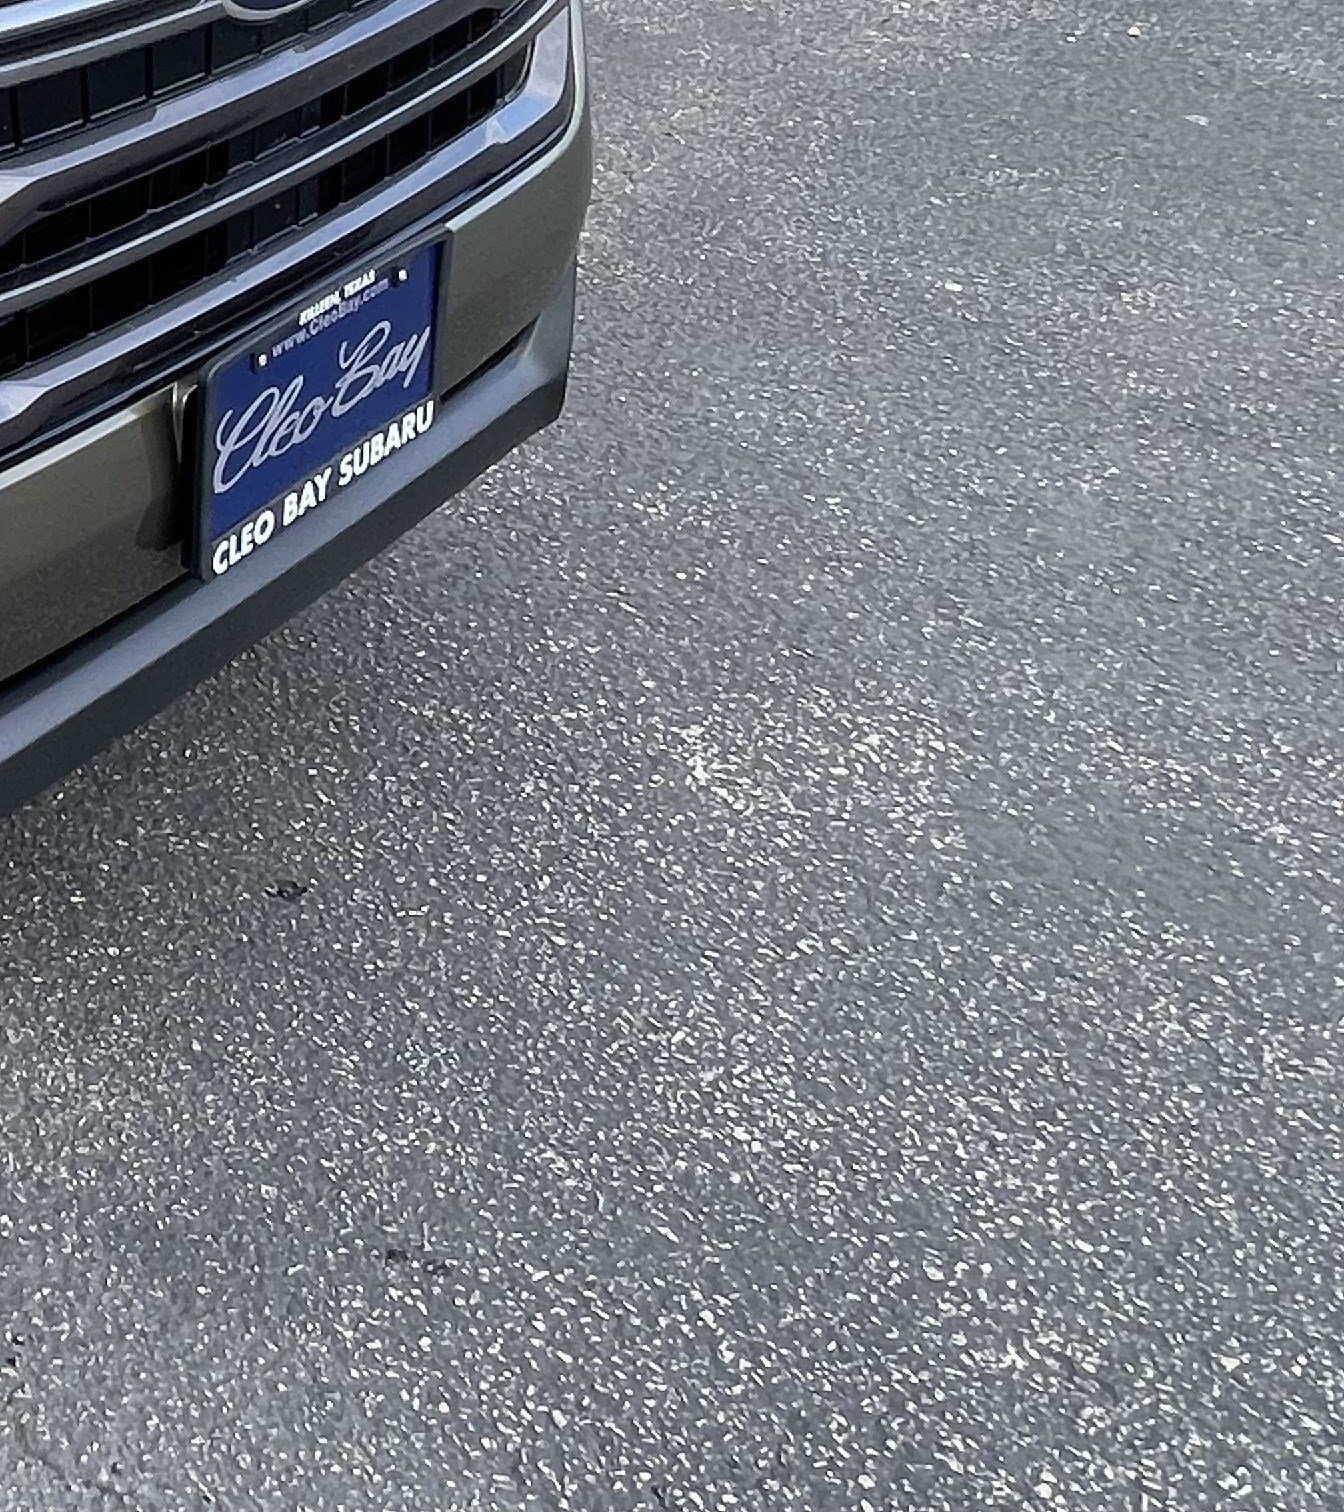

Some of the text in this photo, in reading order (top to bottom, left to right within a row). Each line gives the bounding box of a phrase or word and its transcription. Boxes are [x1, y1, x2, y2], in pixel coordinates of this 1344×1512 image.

[212, 399, 436, 576] CLEO BAY SUBARU
[214, 320, 431, 494] Cleo Bay
